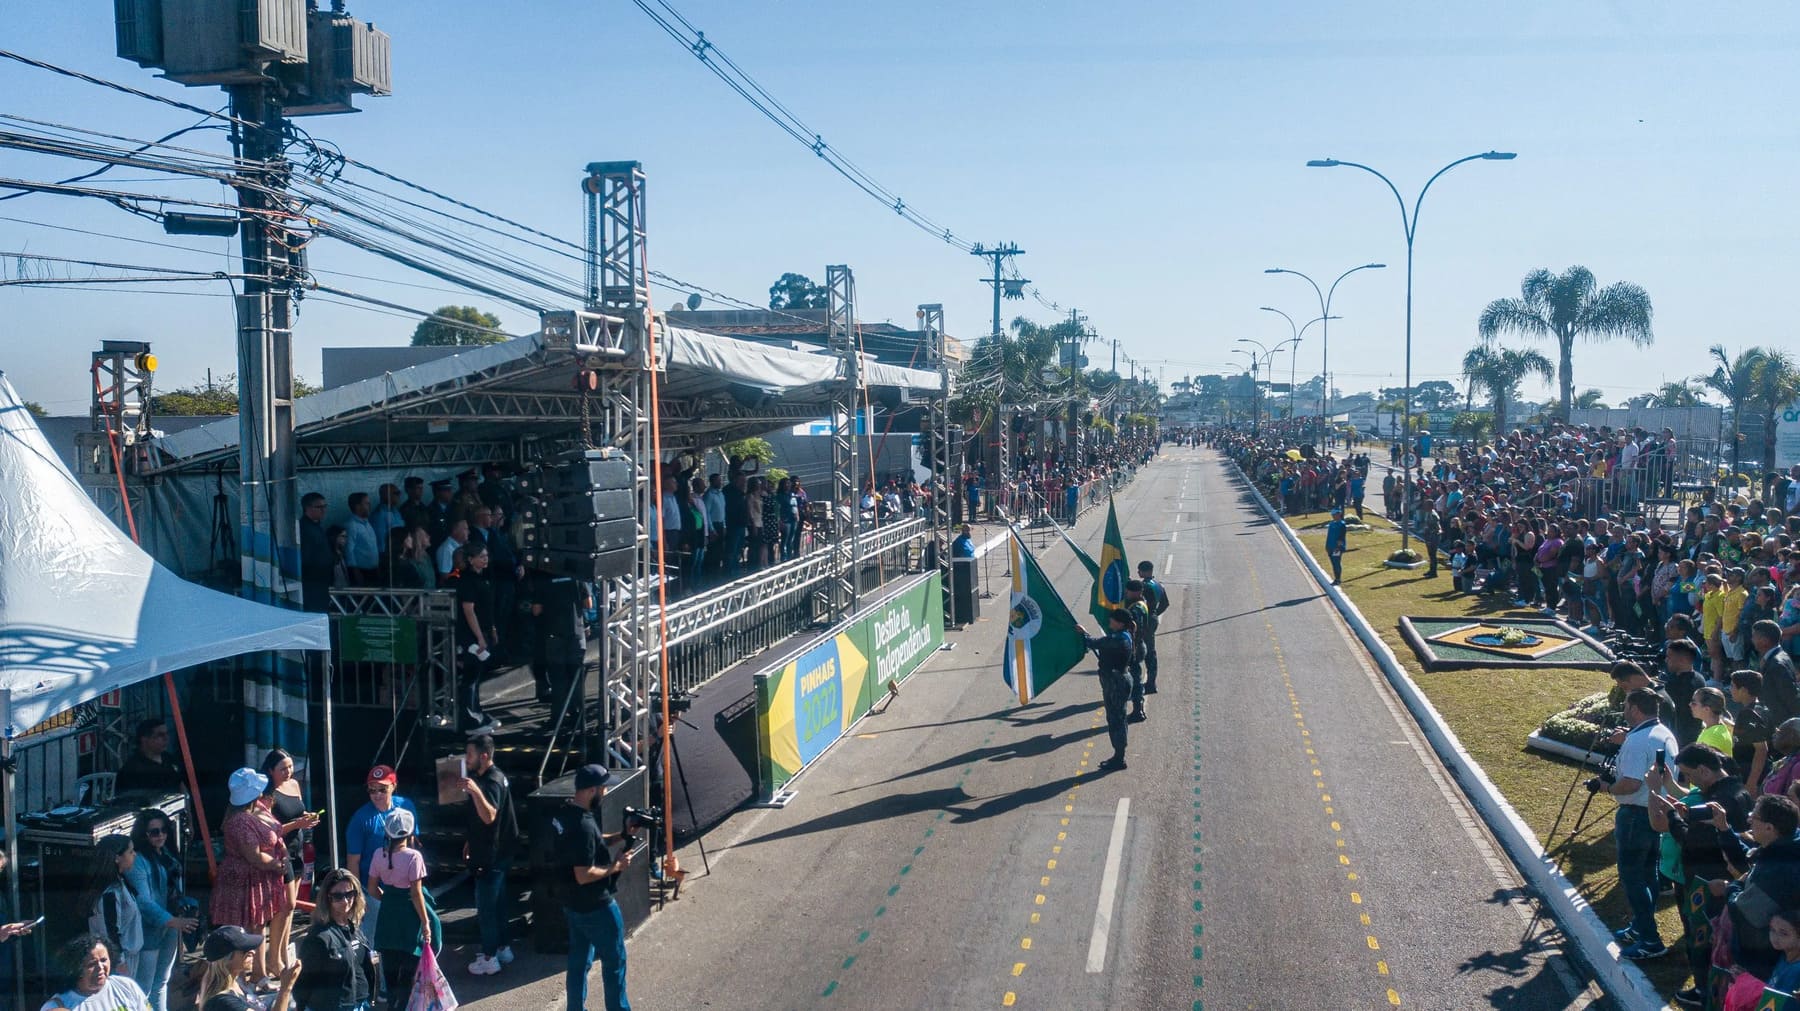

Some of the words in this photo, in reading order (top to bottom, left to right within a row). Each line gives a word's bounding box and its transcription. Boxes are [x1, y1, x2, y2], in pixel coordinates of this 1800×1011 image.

[875, 608, 901, 650] Desfile
[900, 605, 910, 630] da
[876, 620, 931, 685] Independência
[800, 658, 835, 698] PINHAIS
[803, 682, 837, 742] 2022
